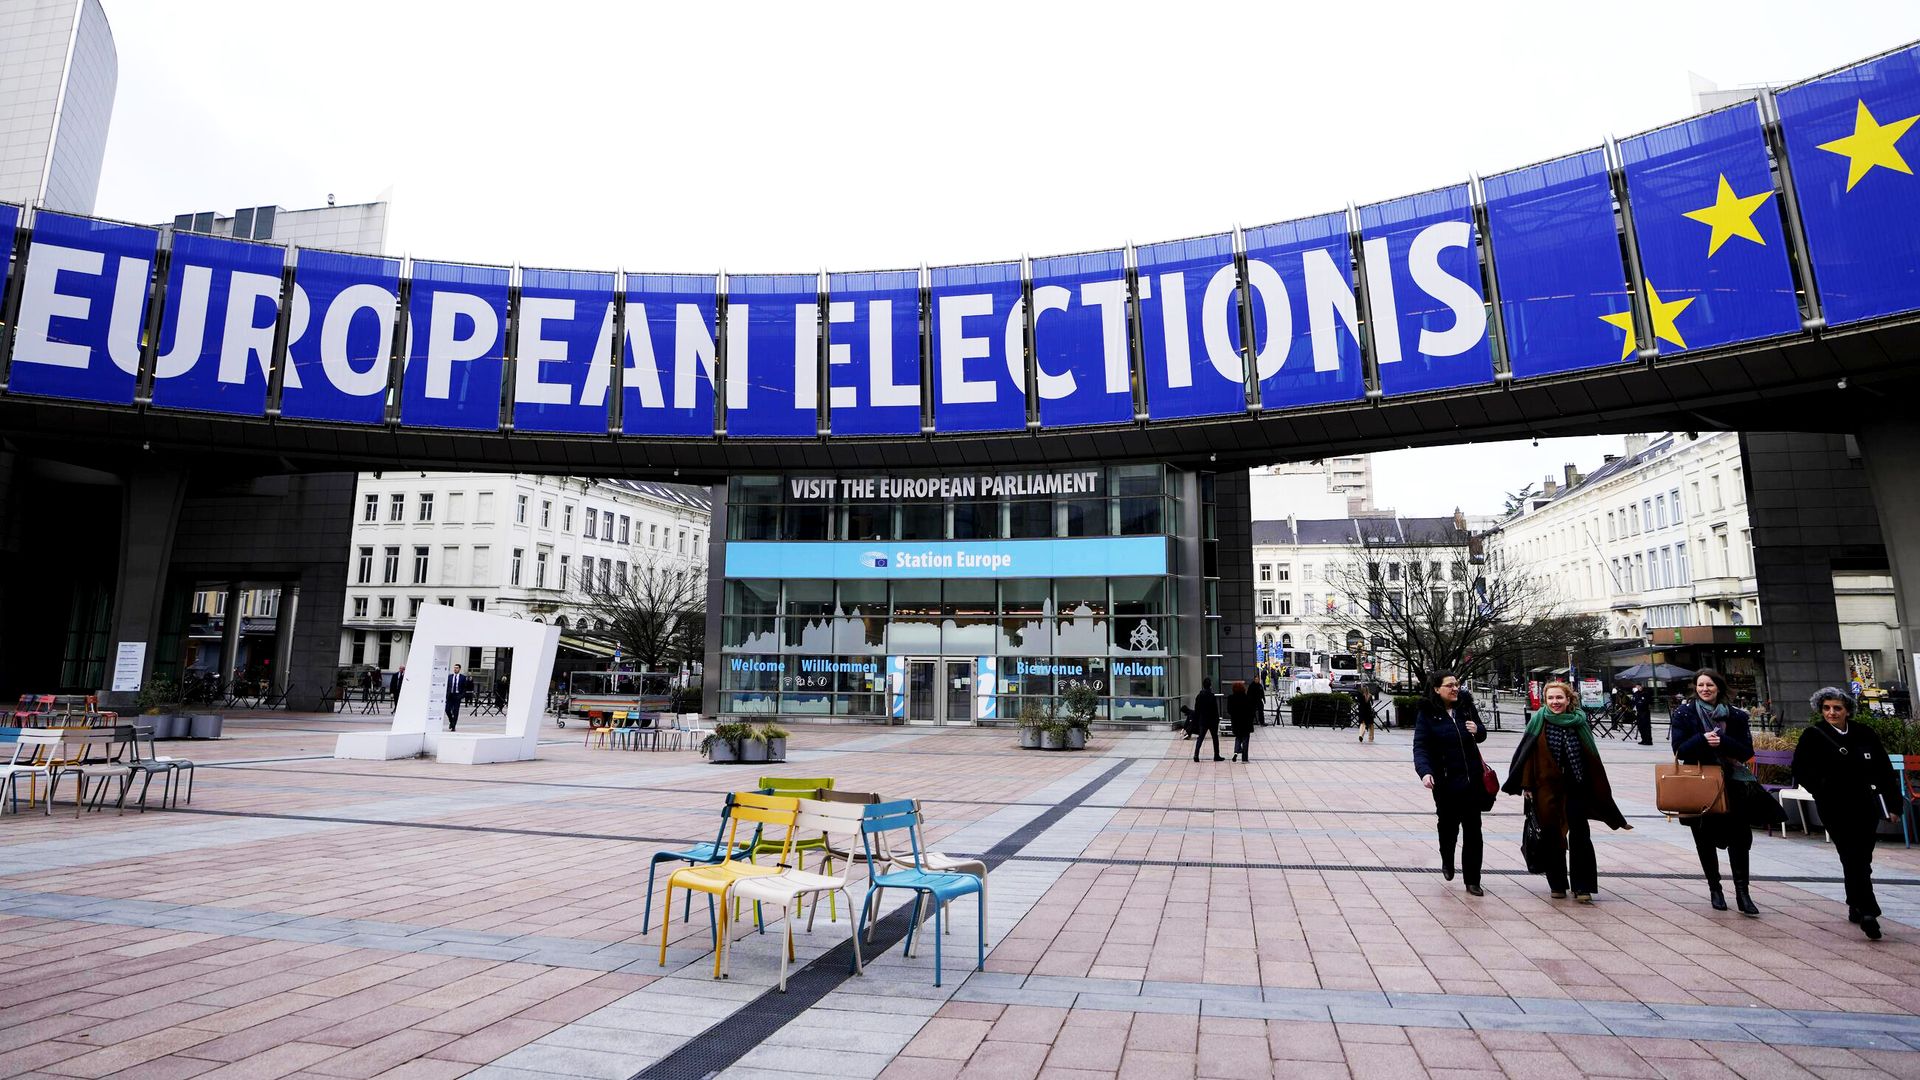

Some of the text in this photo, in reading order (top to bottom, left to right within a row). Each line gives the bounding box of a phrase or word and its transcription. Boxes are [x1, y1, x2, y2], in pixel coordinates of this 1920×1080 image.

[11, 221, 1488, 409] EUROPEAN ELECTIONS
[791, 472, 1098, 499] VISIT THE EUROPEAN PARLIAMENT
[896, 551, 1011, 571] Station Europe
[731, 658, 878, 673] Welcome Willkommen
[1016, 661, 1164, 676] Bienvenue Welkom
